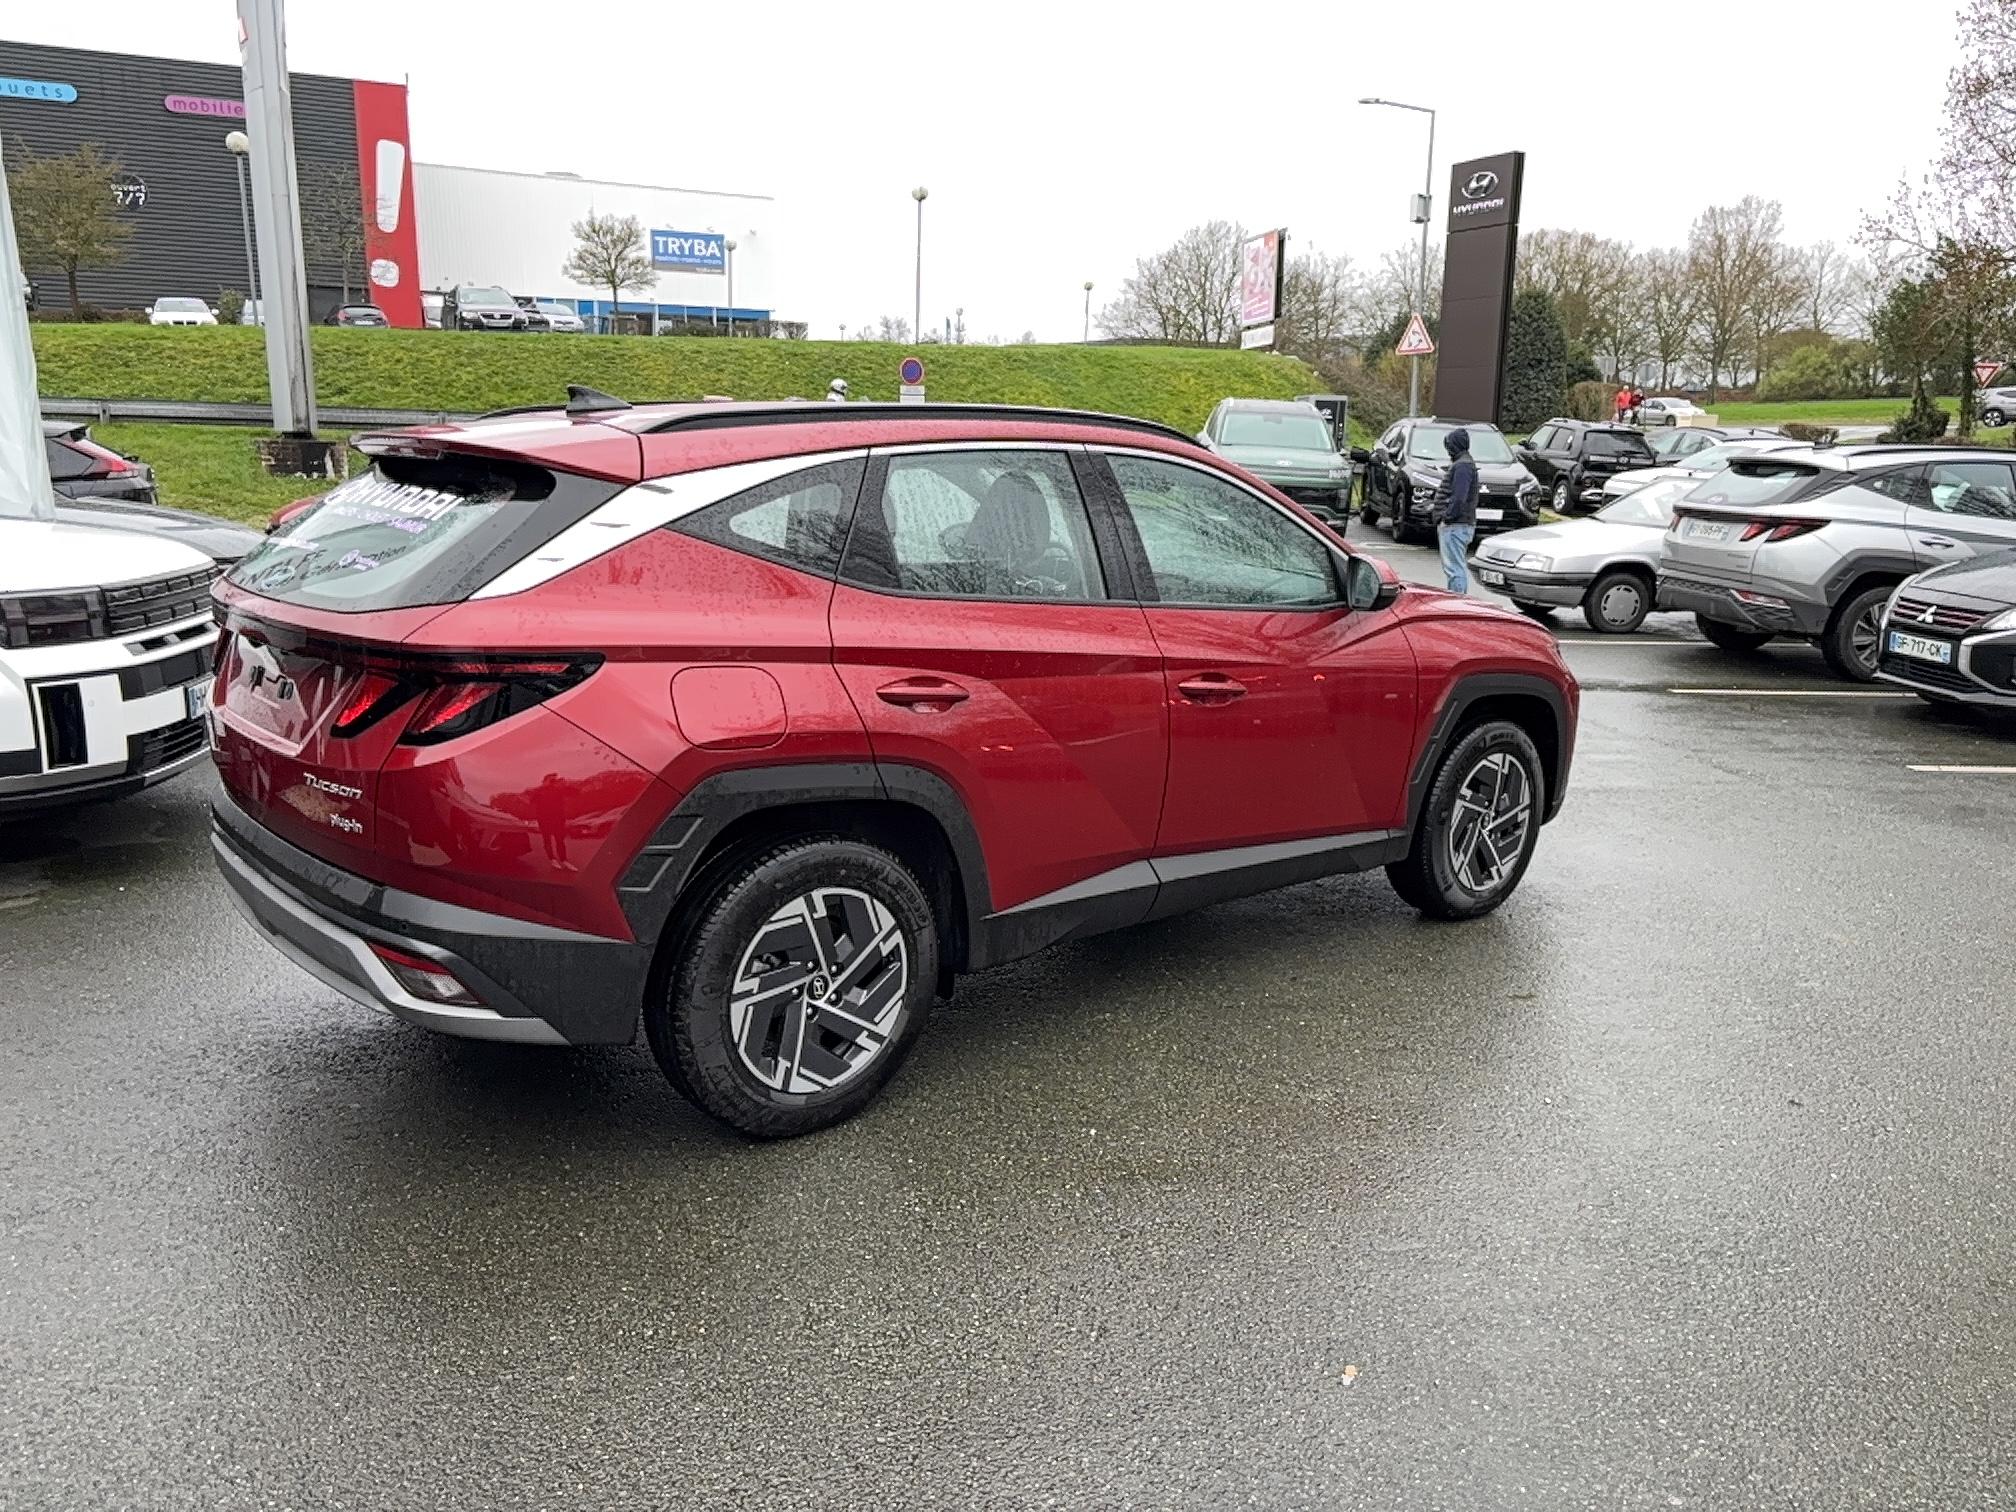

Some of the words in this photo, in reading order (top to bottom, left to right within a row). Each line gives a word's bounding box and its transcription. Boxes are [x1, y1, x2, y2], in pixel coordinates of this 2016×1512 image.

[0, 83, 63, 99] uets
[172, 99, 244, 116] mobilie
[654, 236, 721, 257] TRYBA
